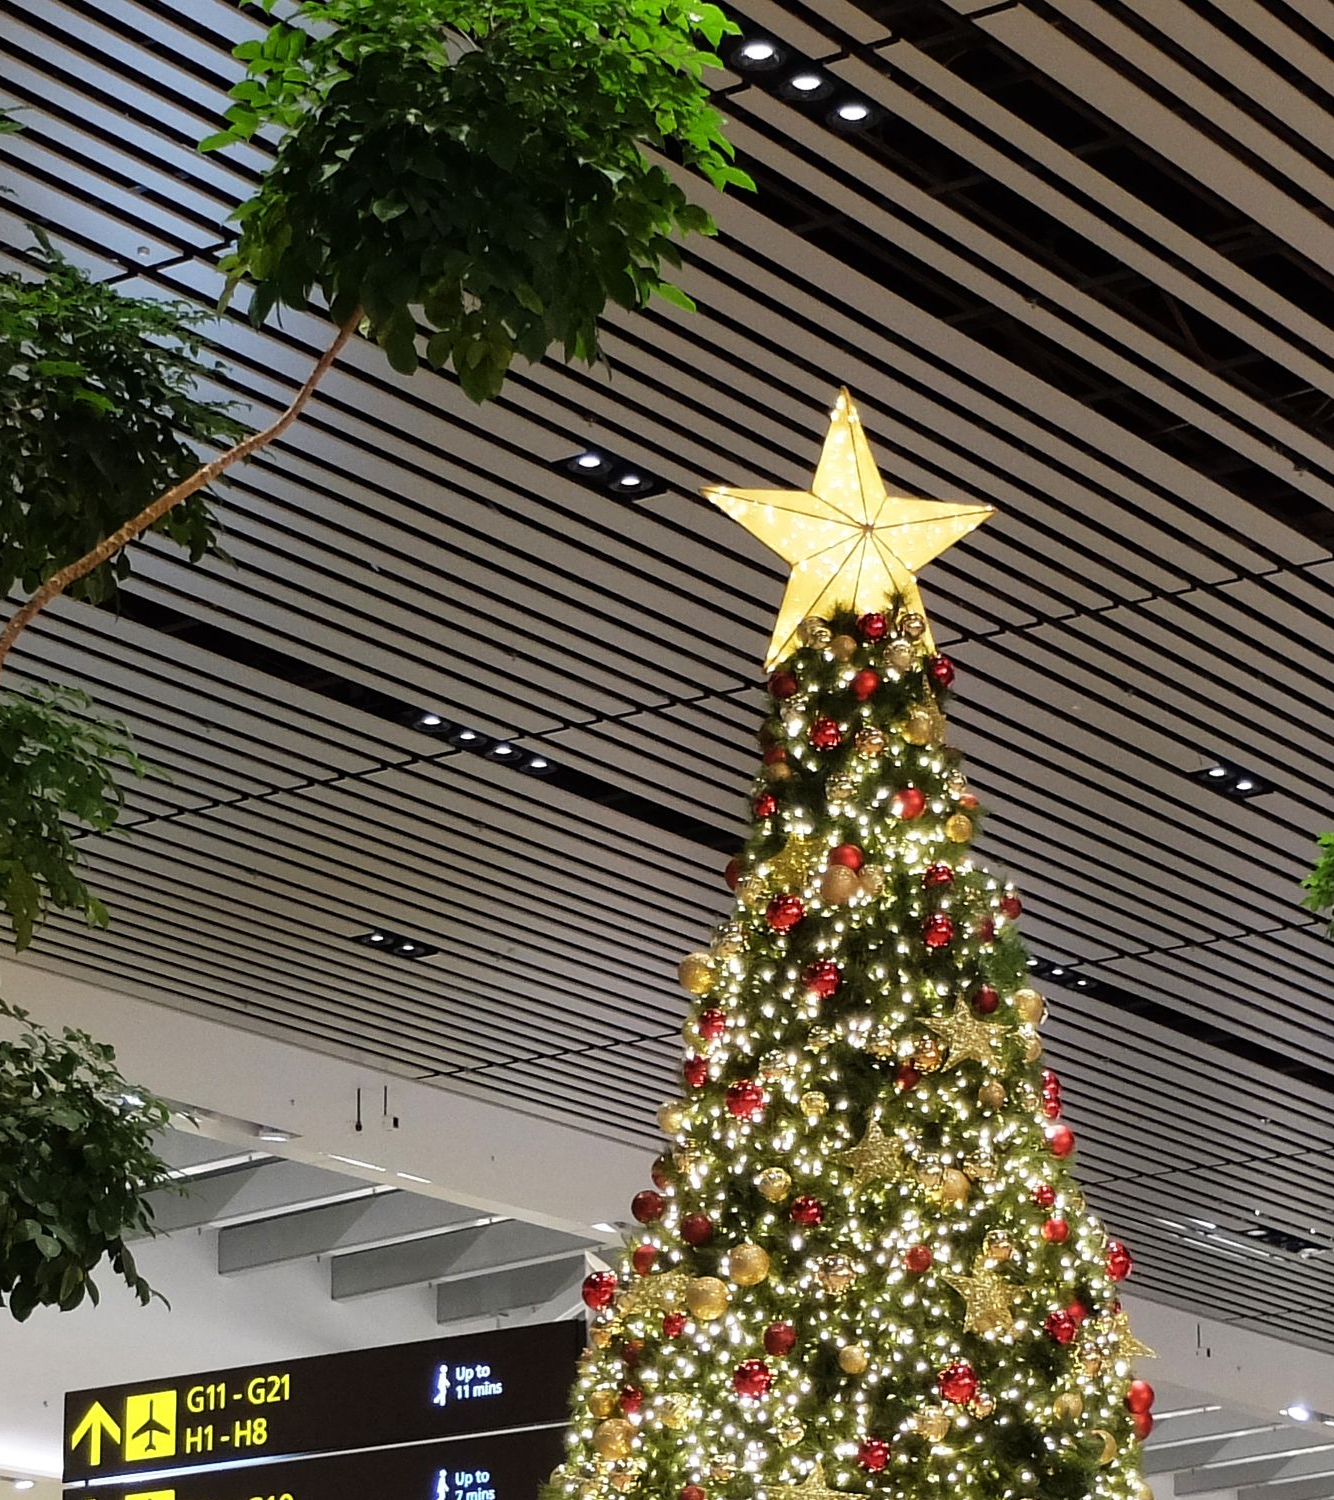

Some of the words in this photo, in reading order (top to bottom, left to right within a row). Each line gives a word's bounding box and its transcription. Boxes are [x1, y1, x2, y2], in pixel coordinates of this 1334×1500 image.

[455, 1366, 474, 1383] Up
[475, 1364, 491, 1379] to
[186, 1382, 226, 1413] G11
[247, 1373, 290, 1405] G21
[455, 1385, 470, 1400] 11
[472, 1381, 503, 1398] mins
[185, 1424, 214, 1454] H1
[234, 1417, 268, 1448] H8
[454, 1471, 474, 1487] Up
[475, 1470, 490, 1484] to
